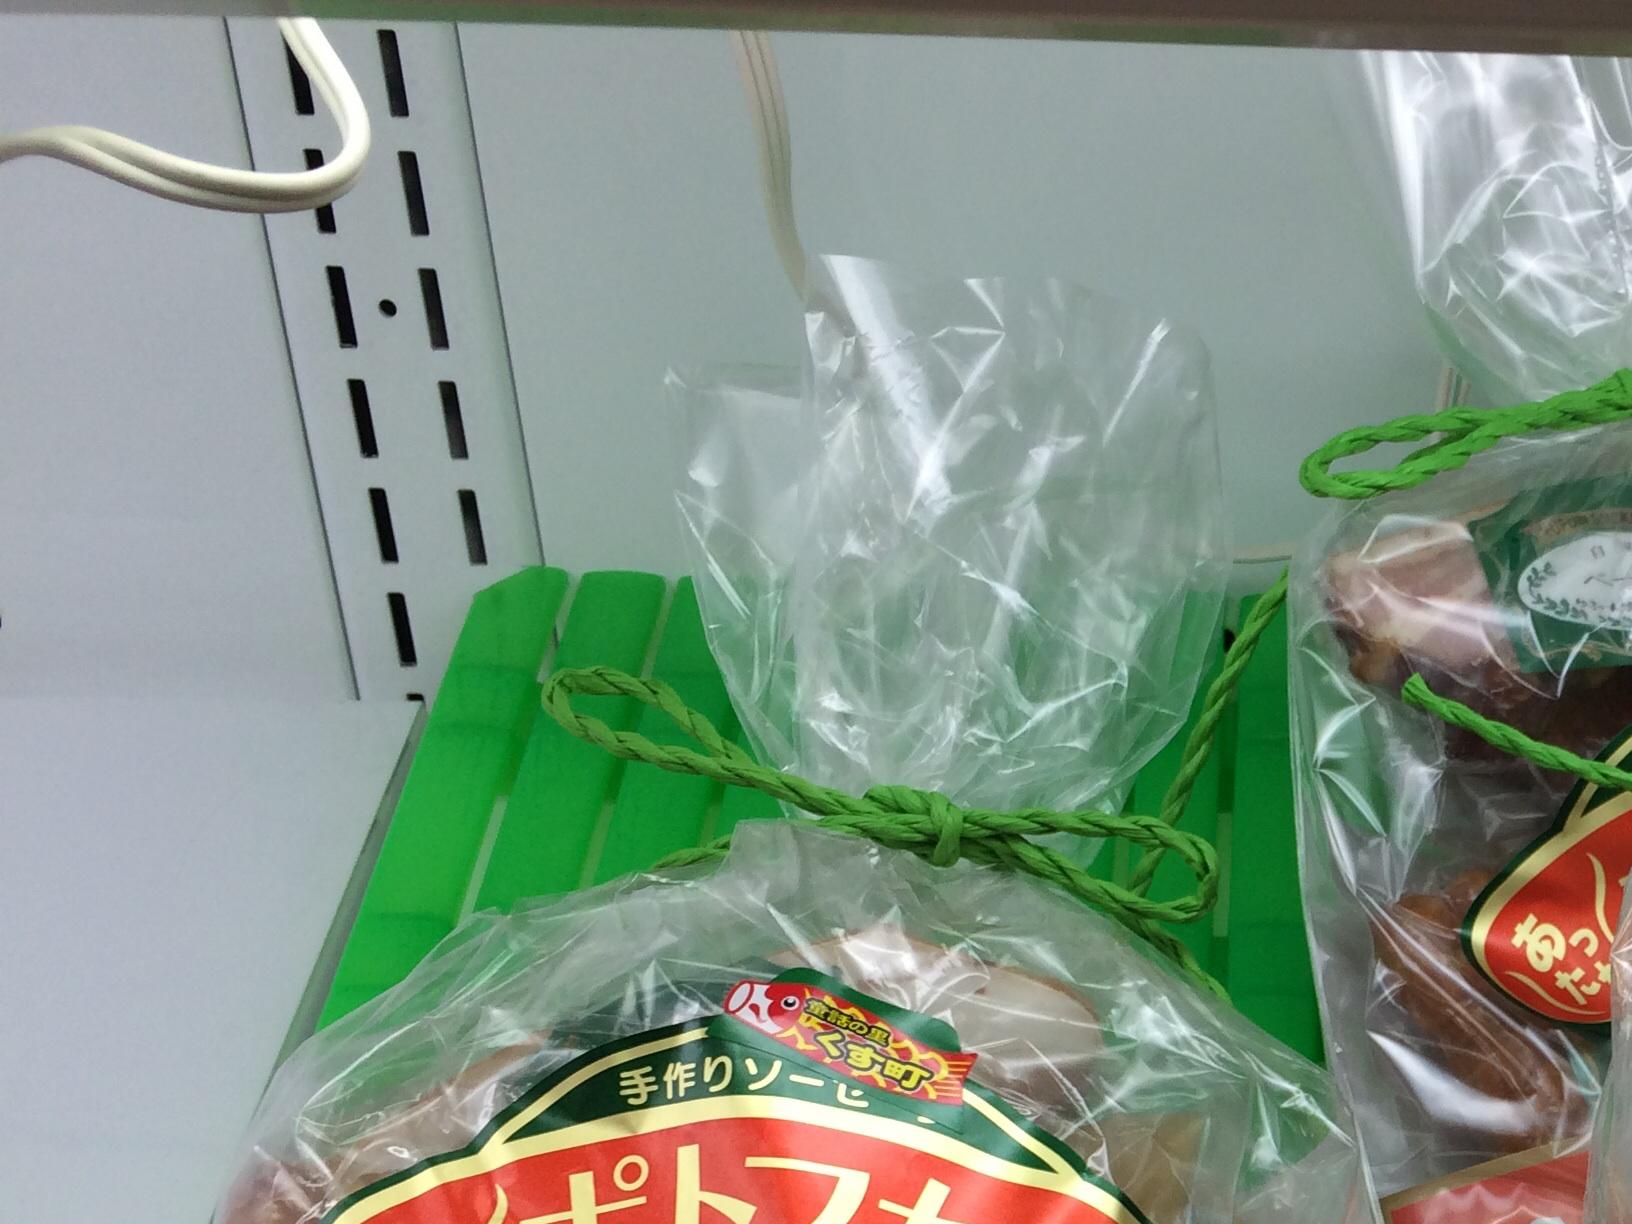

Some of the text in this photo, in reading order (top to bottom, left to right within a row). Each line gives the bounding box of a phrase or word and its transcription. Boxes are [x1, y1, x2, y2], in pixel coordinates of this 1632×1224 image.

[803, 997, 891, 1047] 童話の里
[619, 1055, 905, 1115] 手作りソーセ
[813, 1029, 935, 1092] くす町
